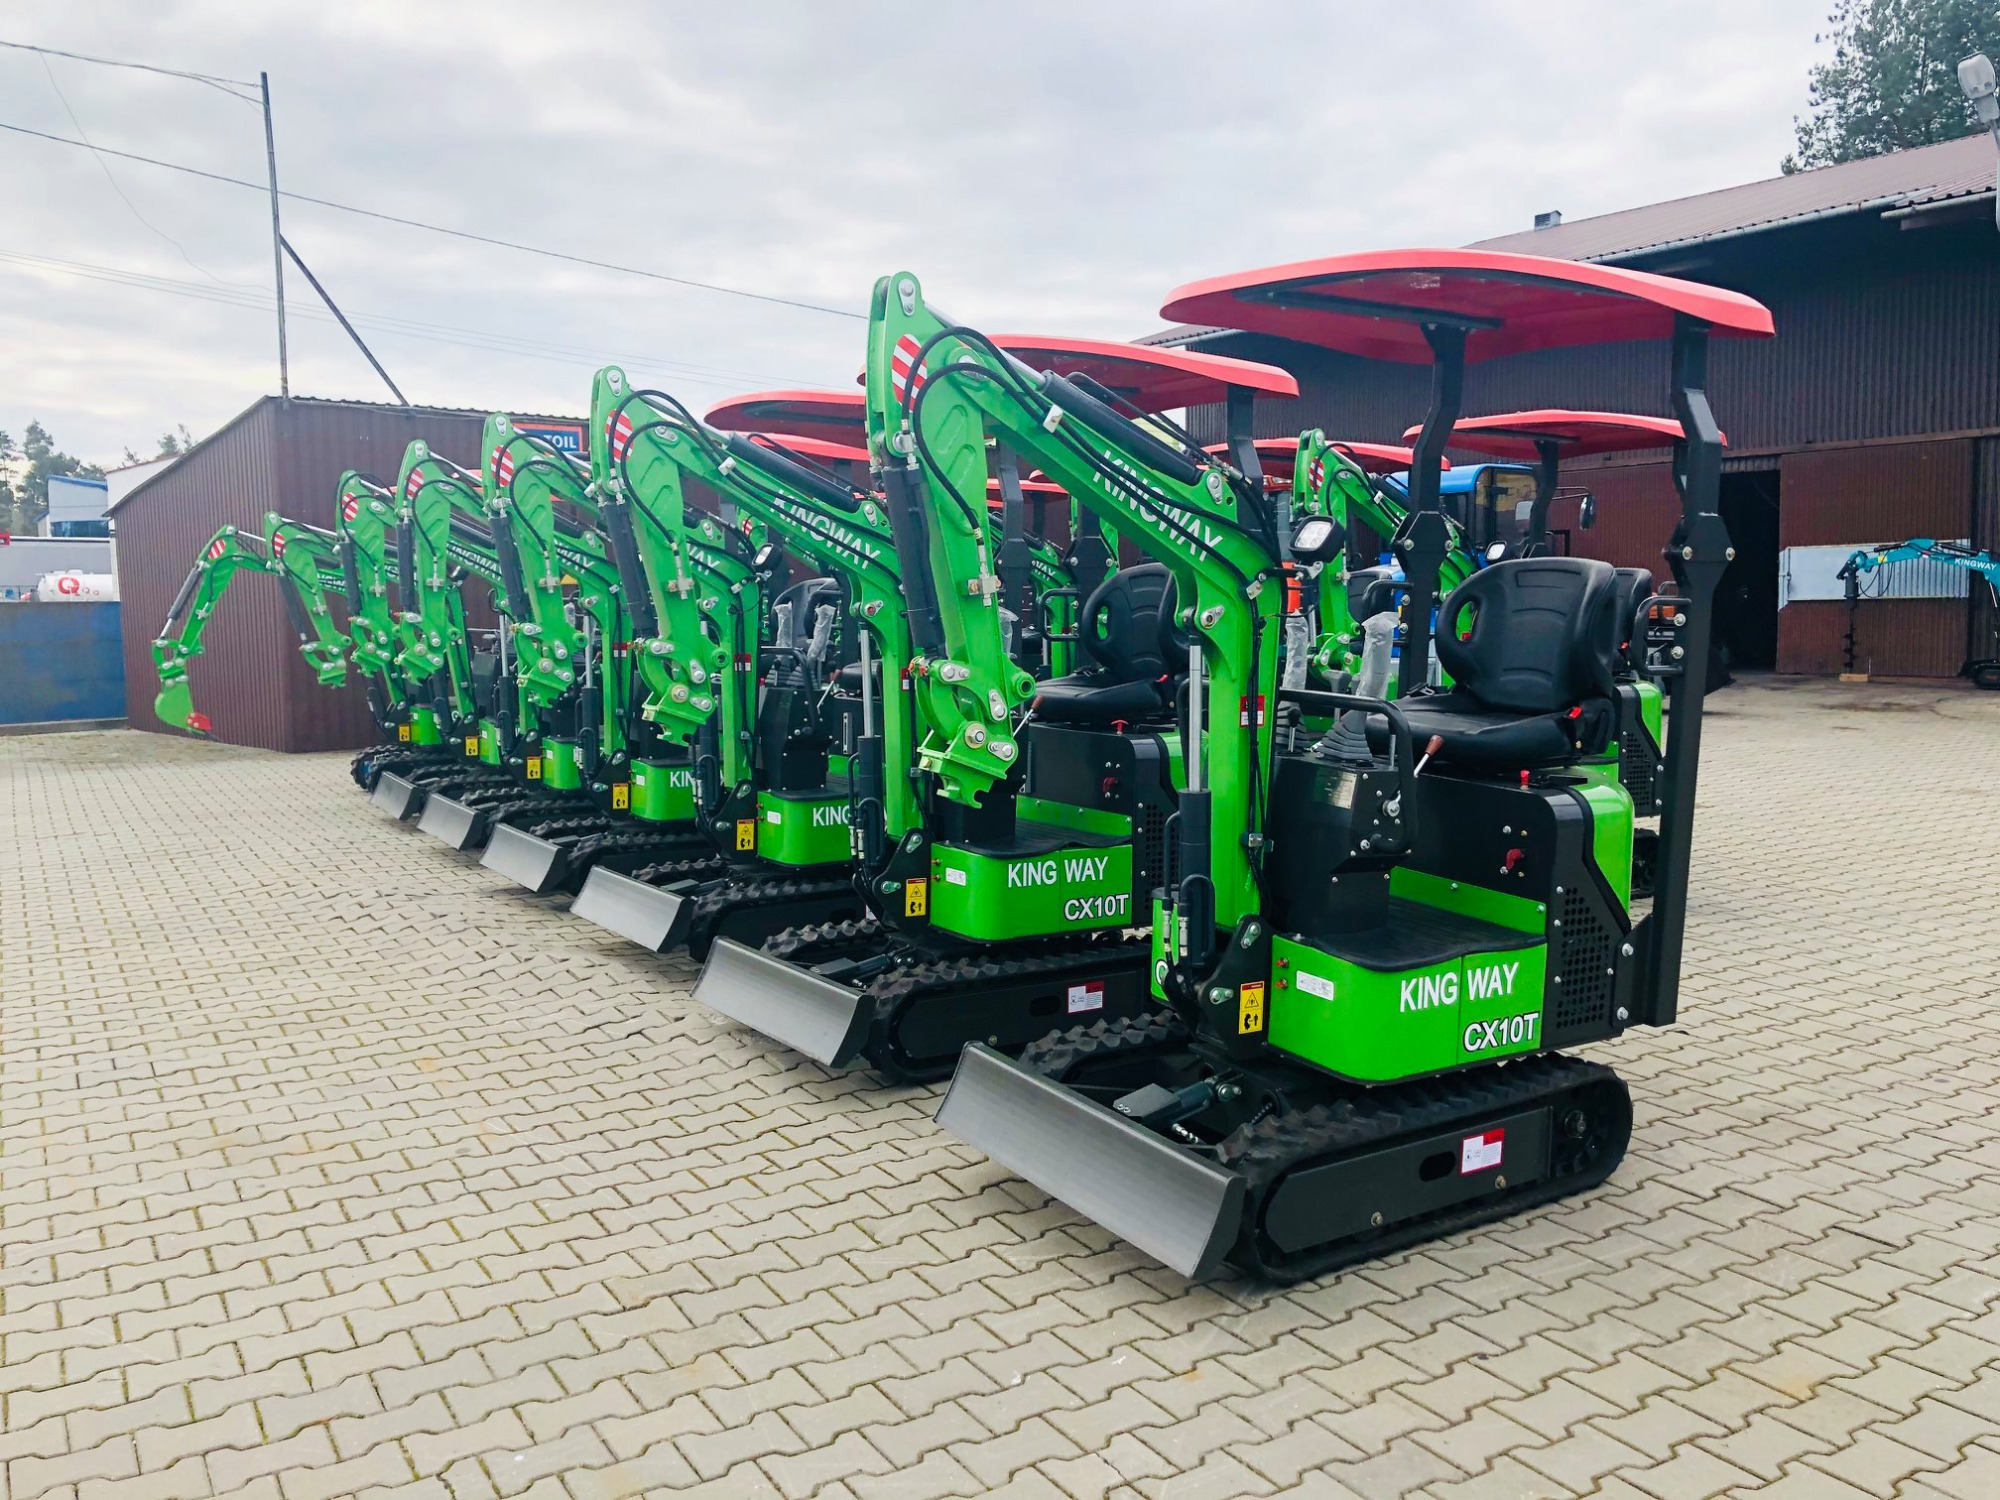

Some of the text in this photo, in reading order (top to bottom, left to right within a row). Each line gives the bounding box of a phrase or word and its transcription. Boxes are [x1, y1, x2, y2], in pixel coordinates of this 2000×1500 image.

[1093, 450, 1223, 562] KINGWAY
[770, 489, 881, 570] KINGWAY
[1954, 557, 1997, 571] KINGWAY
[670, 770, 695, 788] KIN
[1008, 856, 1108, 888] KING WAY
[1064, 894, 1129, 921] CX10T
[1400, 962, 1519, 1013] KING WAY
[1463, 1012, 1540, 1052] CX10T
